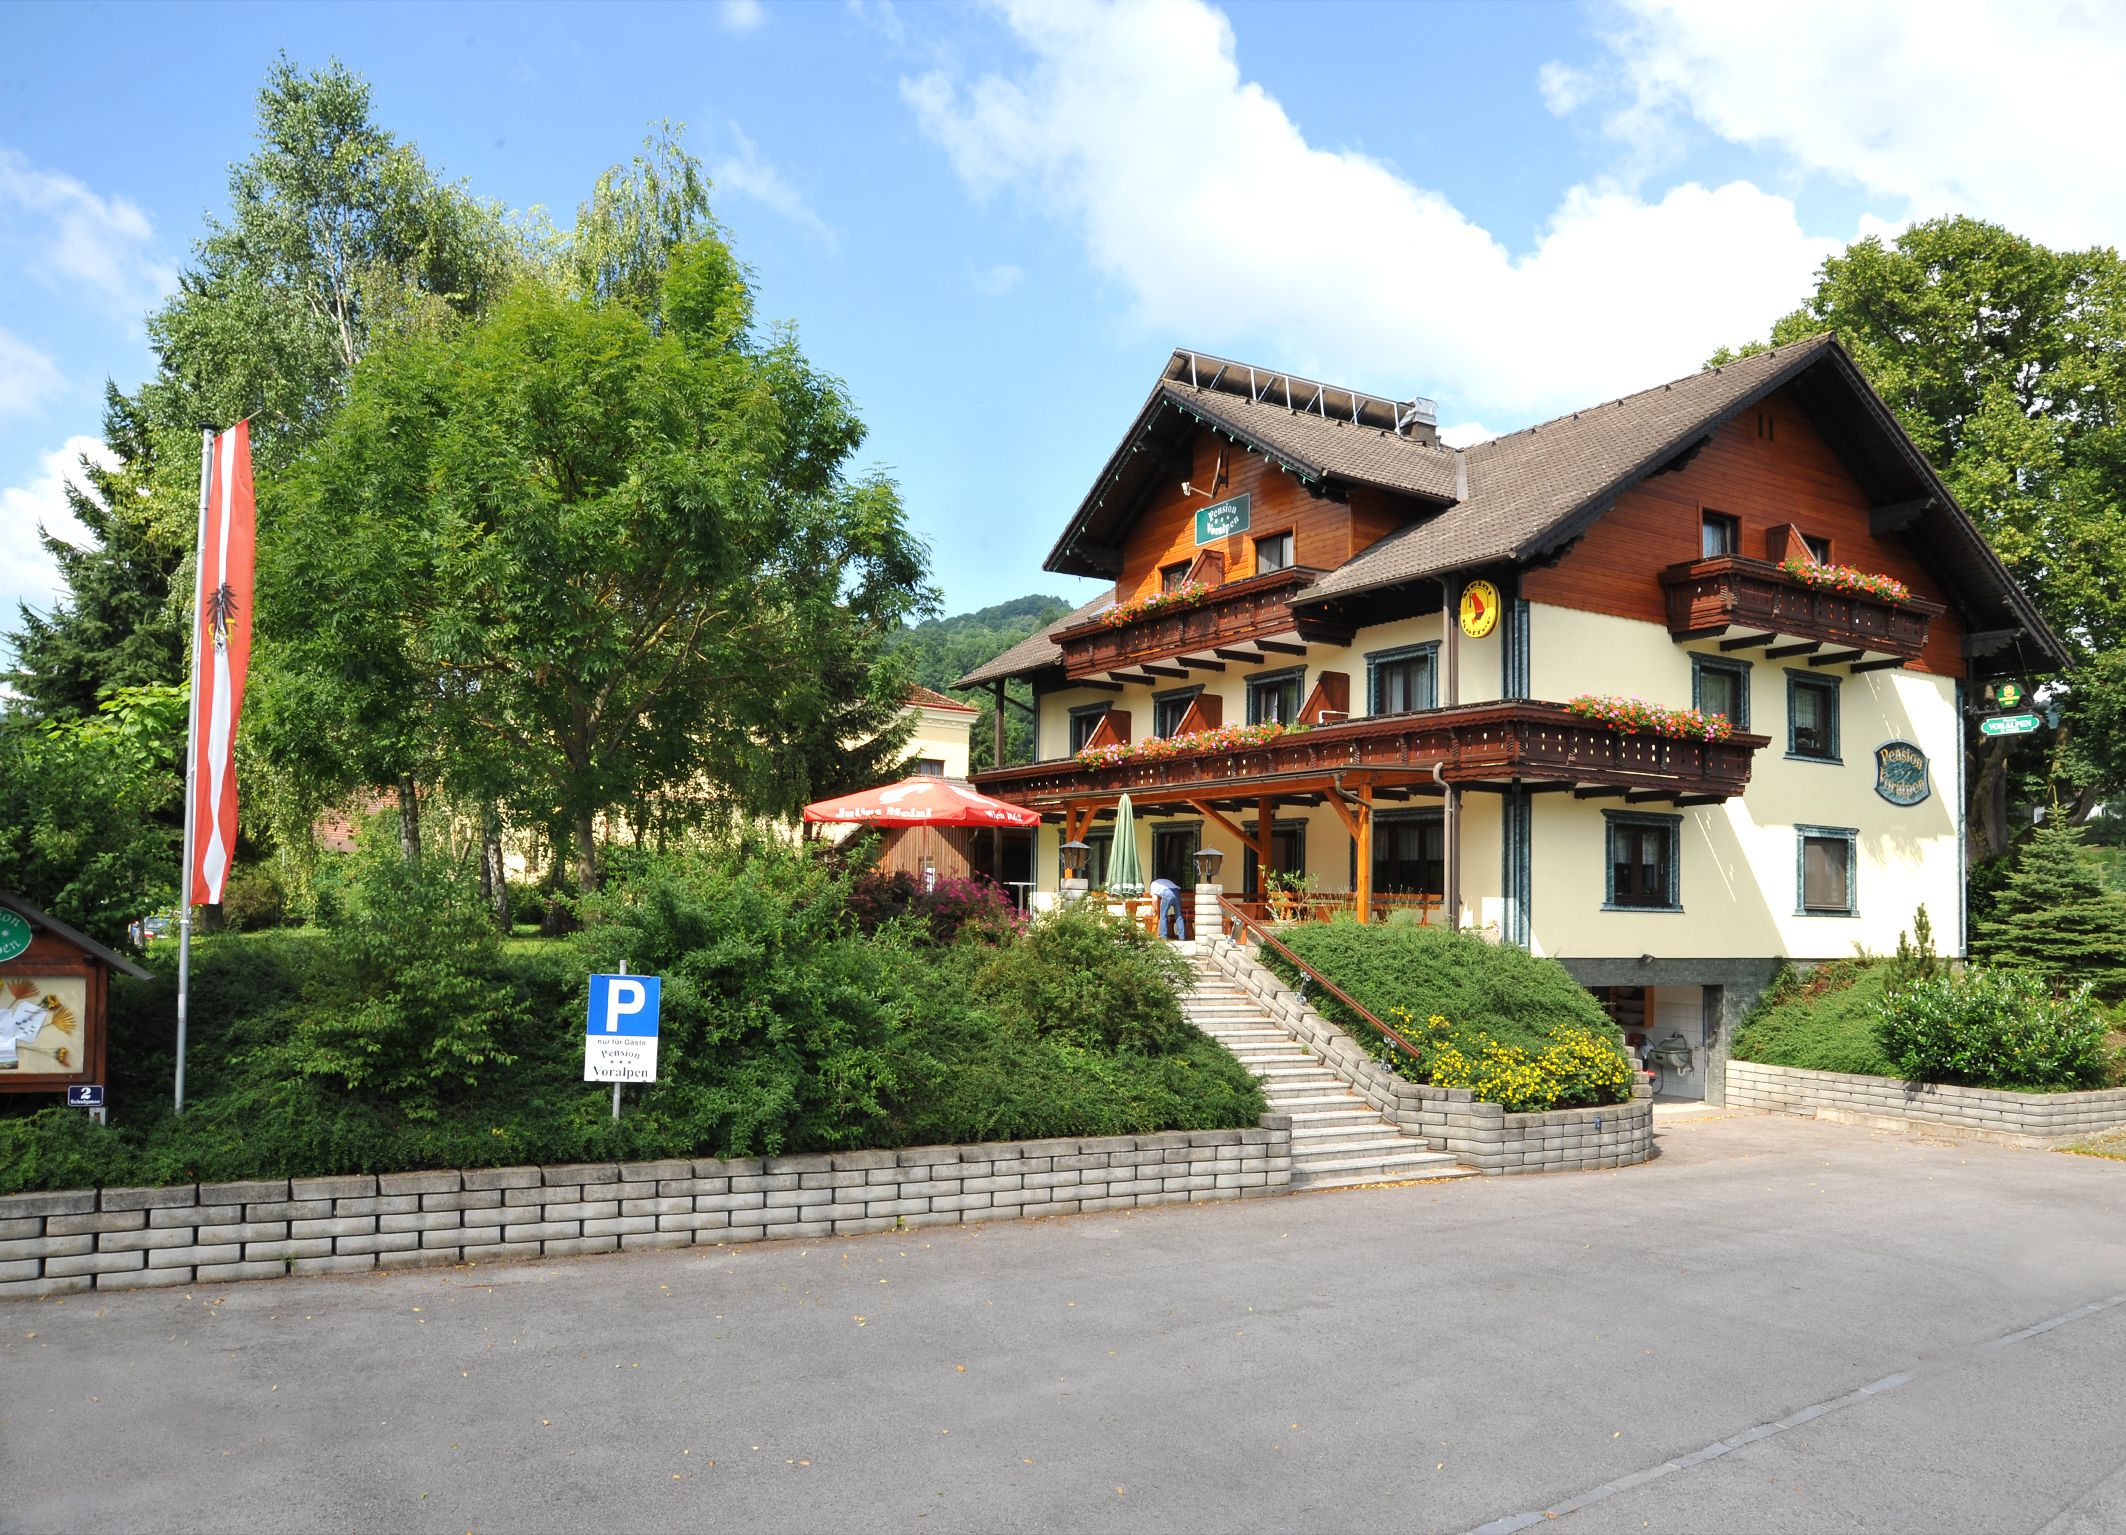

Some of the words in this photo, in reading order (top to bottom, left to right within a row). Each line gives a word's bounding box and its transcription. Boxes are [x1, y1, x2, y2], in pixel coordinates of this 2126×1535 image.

[1208, 503, 1237, 521] Pension
[1880, 748, 1922, 770] Pension
[835, 807, 882, 819] Julius
[886, 806, 932, 818] Meinl
[606, 979, 646, 1033] P
[601, 1048, 641, 1060] Pension
[593, 1065, 648, 1080] Voralpen
[80, 1087, 92, 1100] 2
